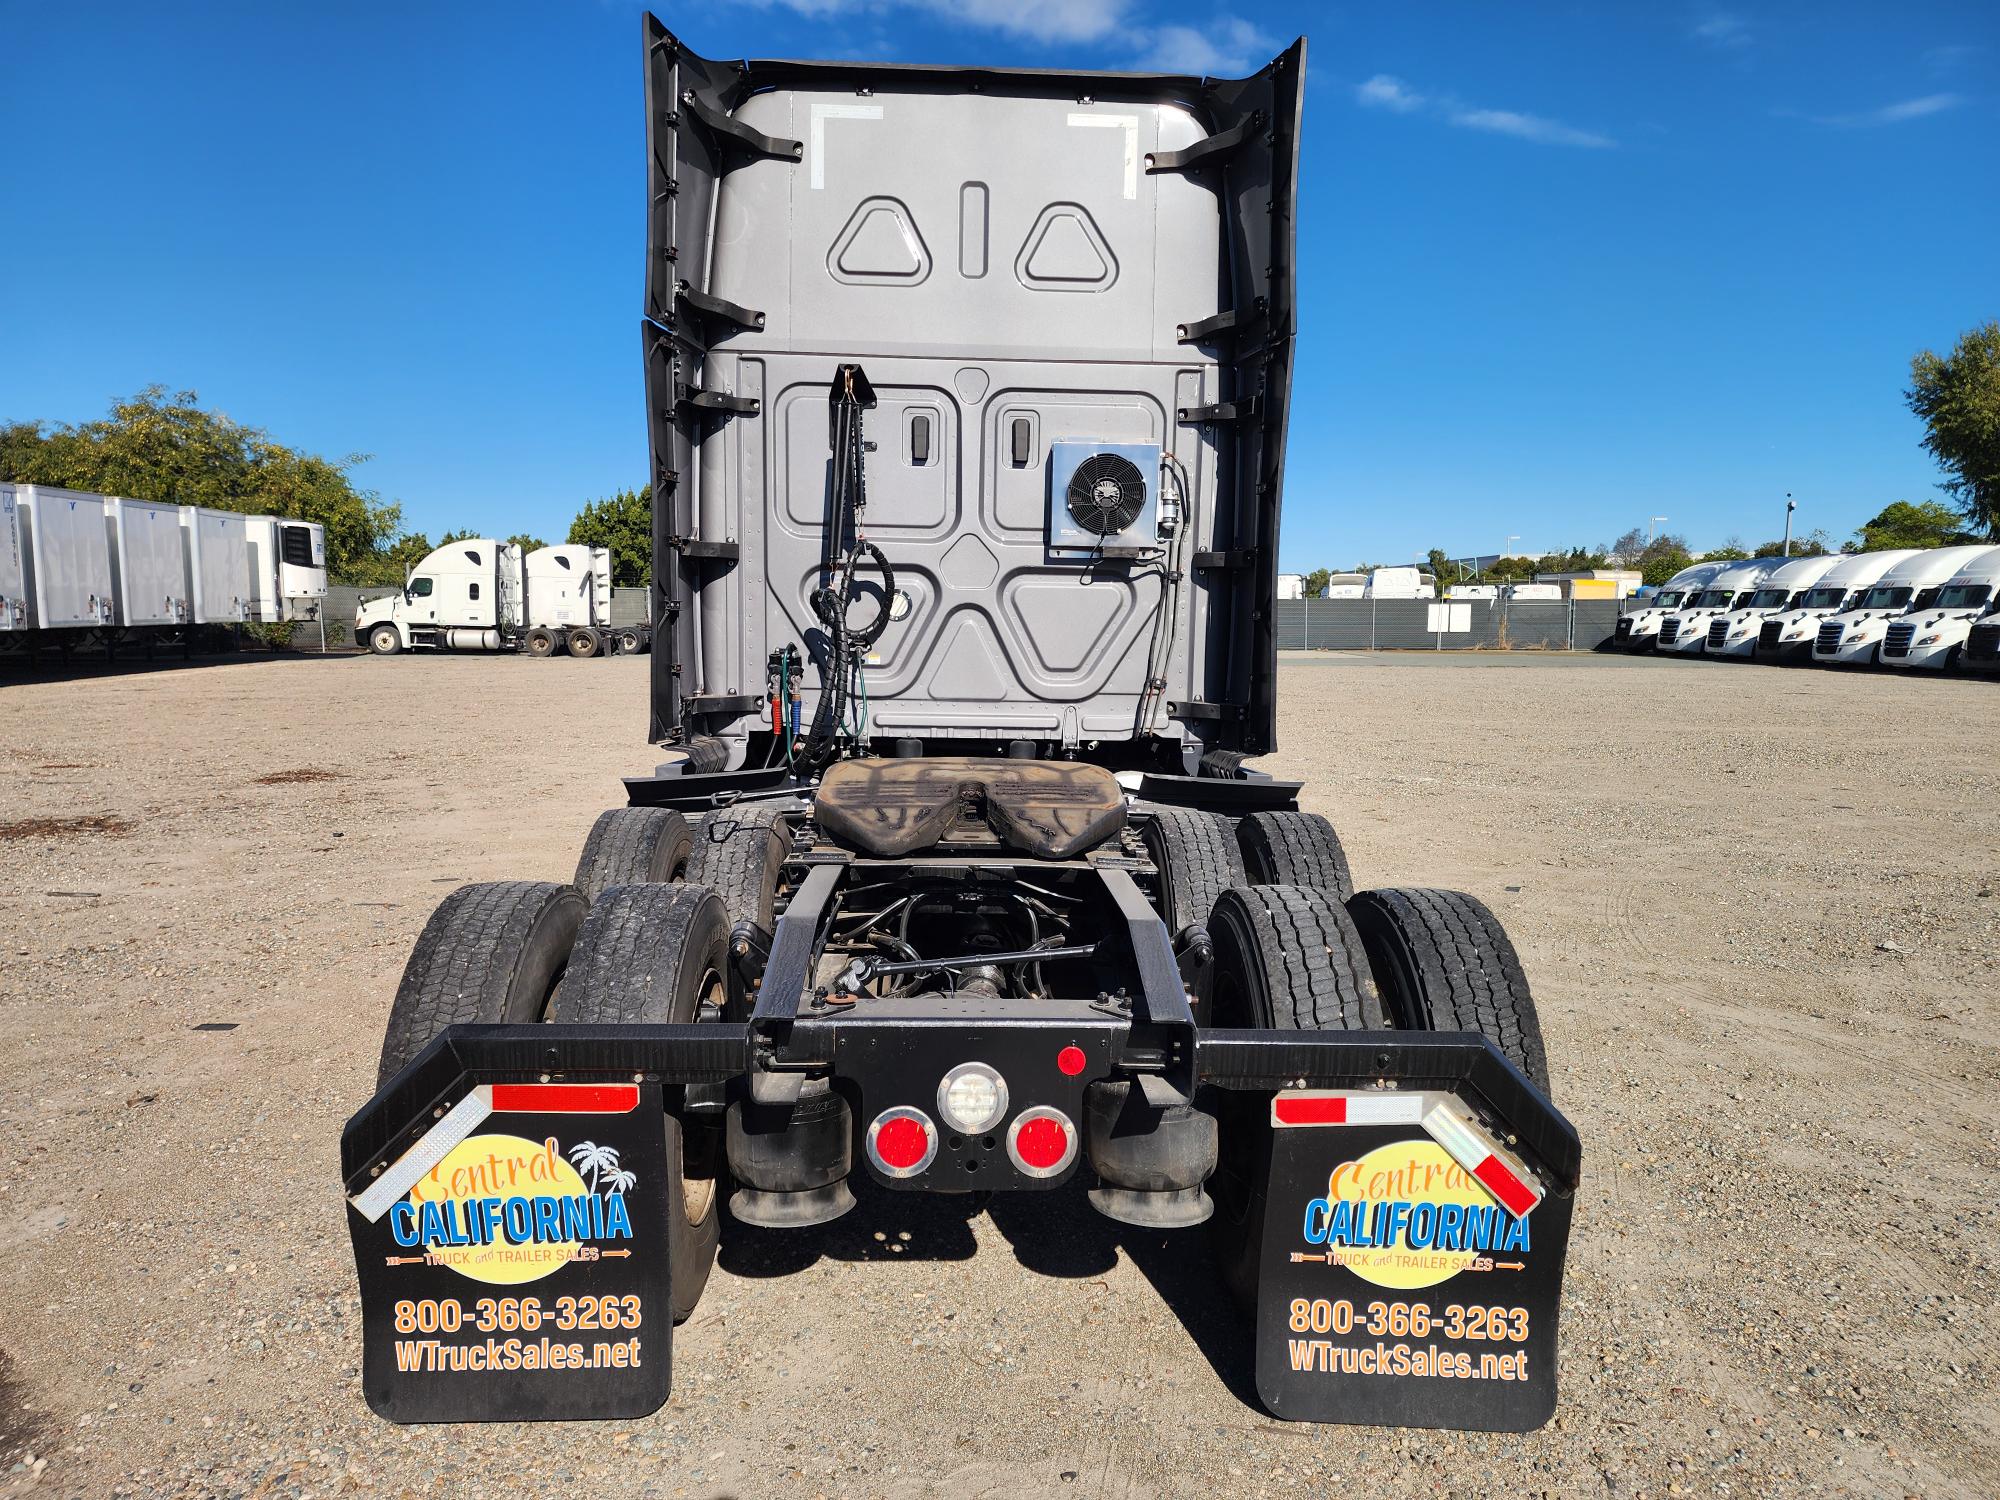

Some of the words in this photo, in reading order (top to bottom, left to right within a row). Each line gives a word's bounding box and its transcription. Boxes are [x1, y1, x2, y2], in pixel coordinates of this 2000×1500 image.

[390, 1192, 633, 1247] CALIFORNIA
[1304, 1198, 1530, 1252] CALIFORNIA
[424, 1250, 471, 1266] TRUCK
[475, 1248, 495, 1264] and
[497, 1249, 552, 1263] TRAILER
[556, 1246, 600, 1262] SALES
[1326, 1251, 1370, 1266] TRUCK
[1373, 1252, 1393, 1267] and
[1395, 1255, 1447, 1270] TRAILER
[1451, 1257, 1494, 1272] SALES
[394, 1295, 642, 1333] 800-366-3263
[1288, 1298, 1529, 1342] 800-366-3263
[394, 1336, 642, 1372] WTruckSales.net
[1288, 1339, 1529, 1381] WTruckSales.net
